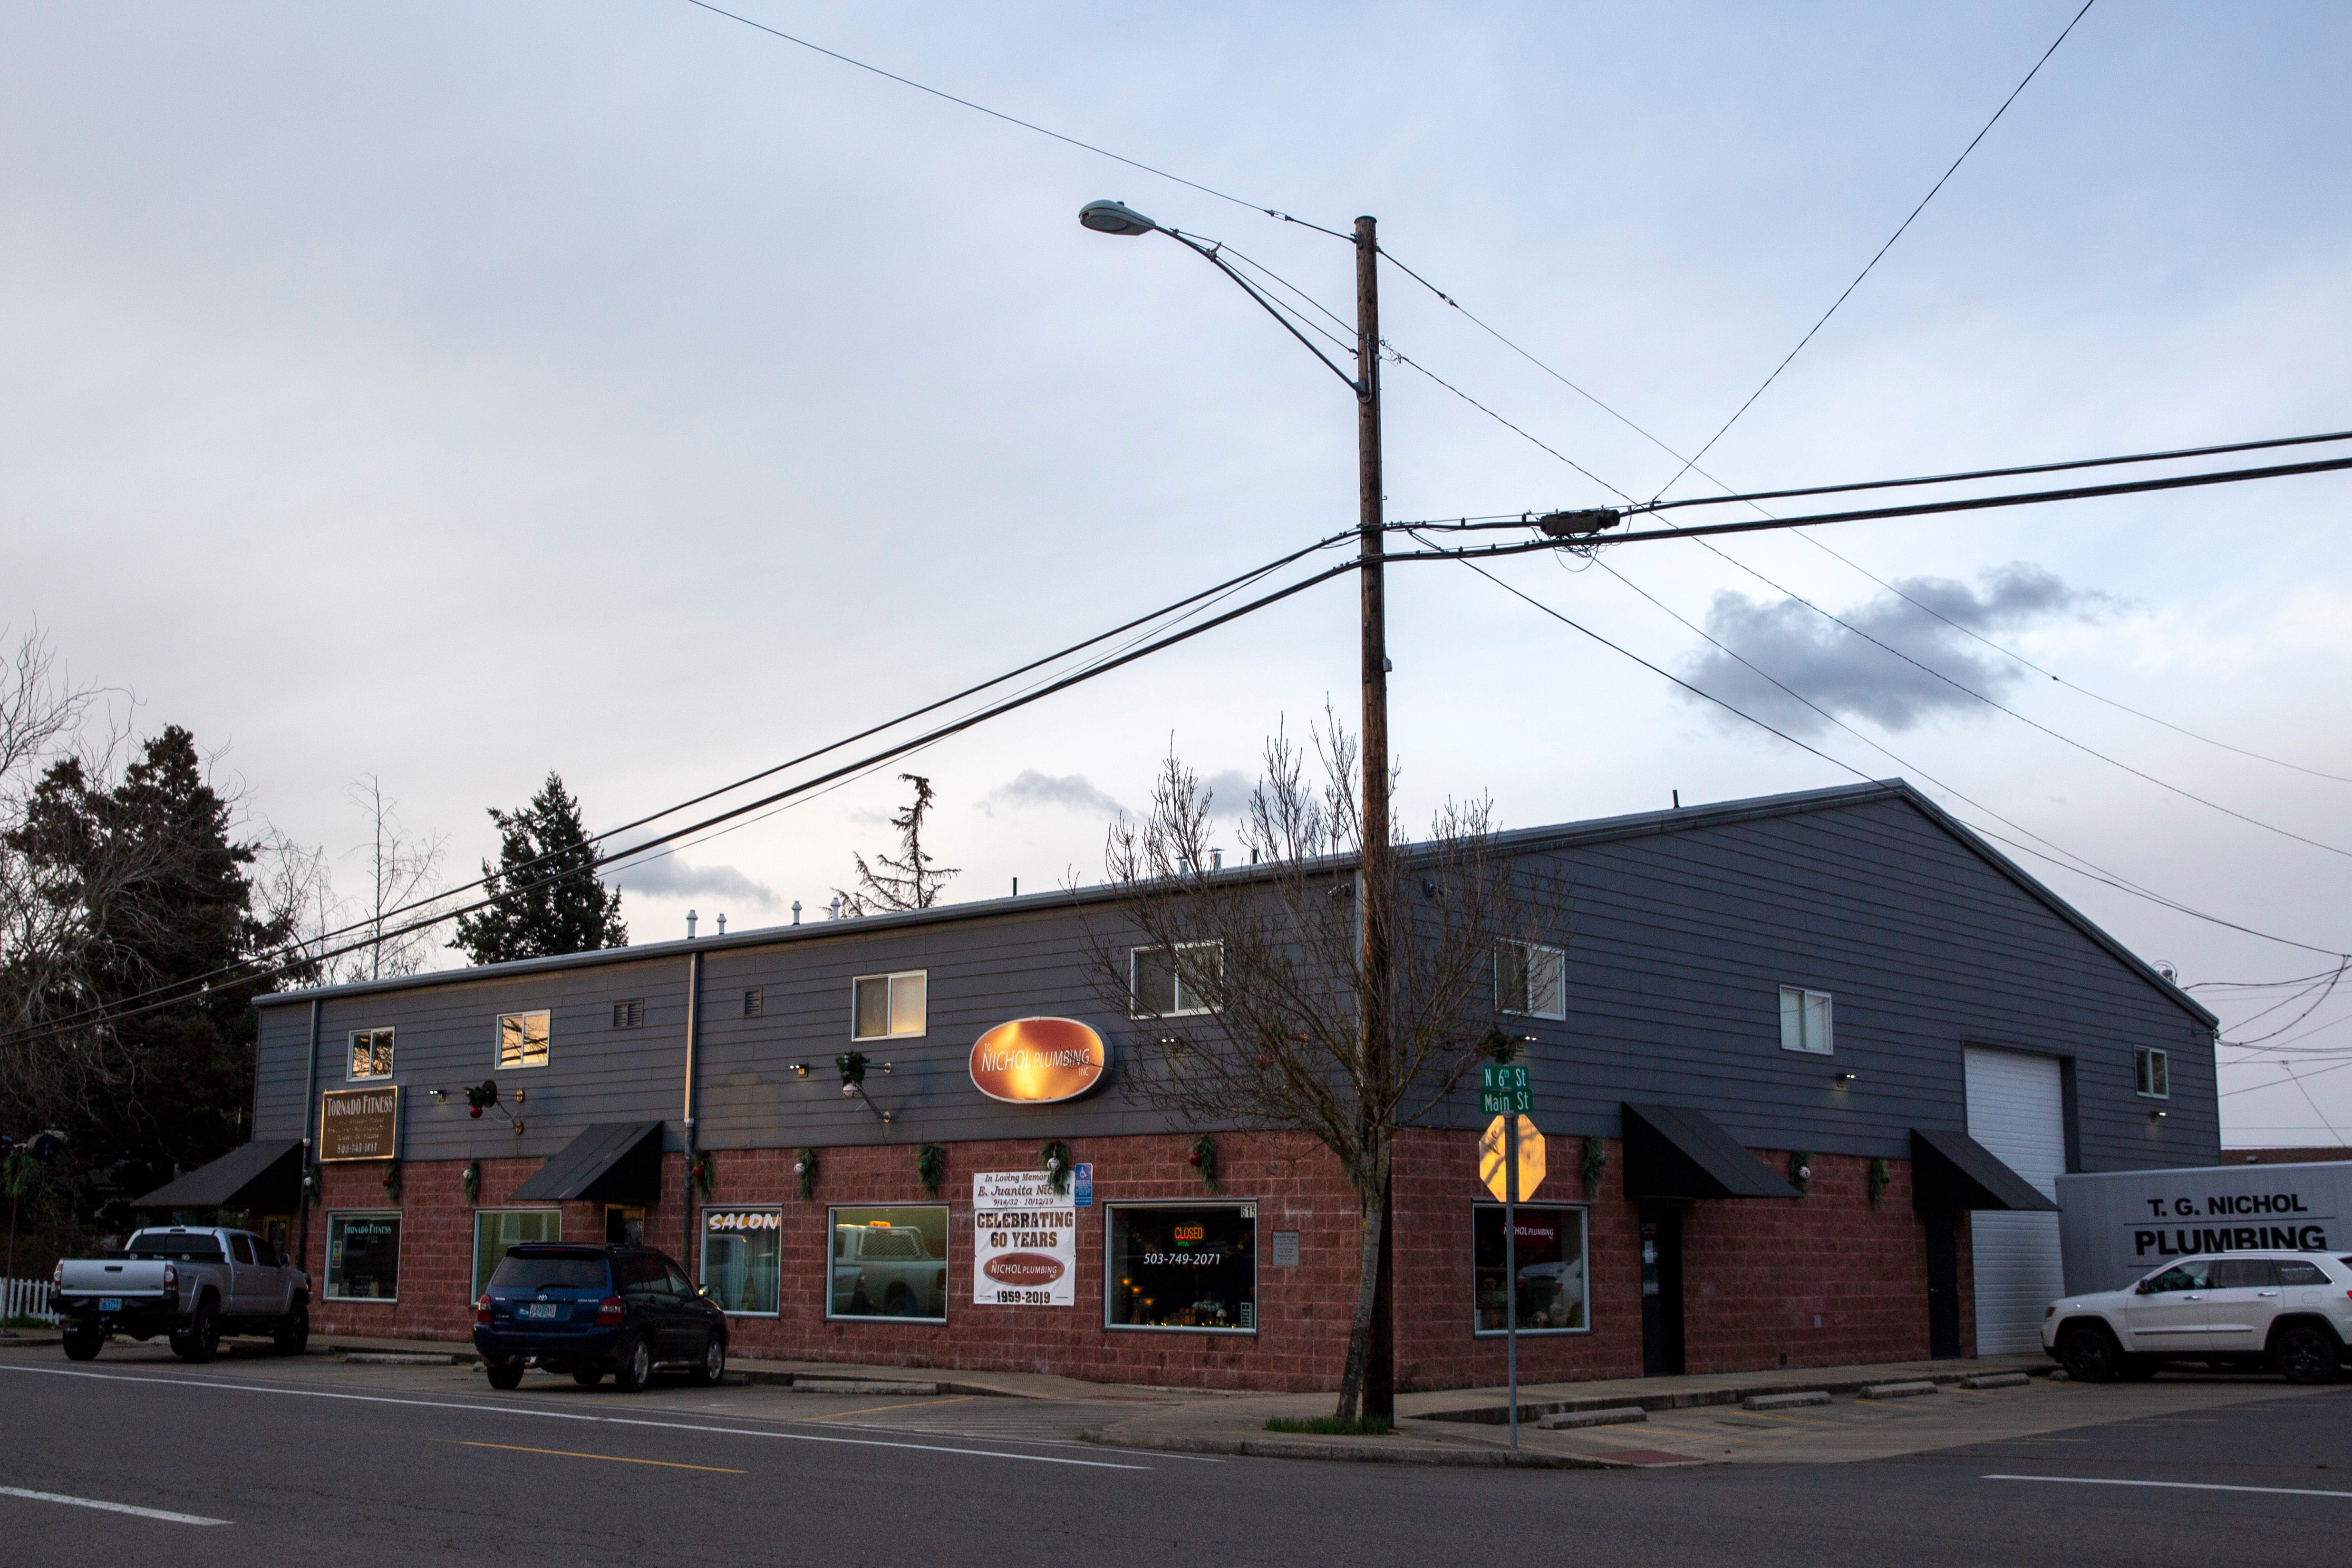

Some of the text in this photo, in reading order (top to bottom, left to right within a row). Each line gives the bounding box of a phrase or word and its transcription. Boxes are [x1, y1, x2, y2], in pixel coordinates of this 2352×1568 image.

[984, 1043, 991, 1052] TG
[982, 1048, 1090, 1072] NICHOL PLUMBING
[1079, 1067, 1089, 1076] INC
[1485, 1068, 1526, 1087] N 6th St
[327, 1095, 393, 1116] TORNADO FITNESS
[1485, 1091, 1529, 1112] Main St
[995, 1173, 1019, 1183] Loving
[978, 1186, 987, 1196] E.
[991, 1185, 1032, 1196] Juanita
[1036, 1184, 1070, 1195] Nicl
[1024, 1198, 1054, 1206] 10/12/19
[2147, 1193, 2308, 1217] T. G. NICHOL
[1241, 1206, 1256, 1218] 615
[709, 1213, 780, 1230] SALON
[977, 1211, 1073, 1229] CELEBRATING
[345, 1223, 391, 1234] TORNADO FITNESS
[1175, 1227, 1203, 1239] CLOSED
[1504, 1226, 1528, 1235] NHOL
[991, 1231, 1057, 1248] 60 YEARS
[2134, 1225, 2328, 1256] PLUMBING
[1143, 1253, 1220, 1265] 503-749-2071
[991, 1264, 1057, 1274] NICHOL PLUMBING
[997, 1290, 1050, 1304] 1959-2019
